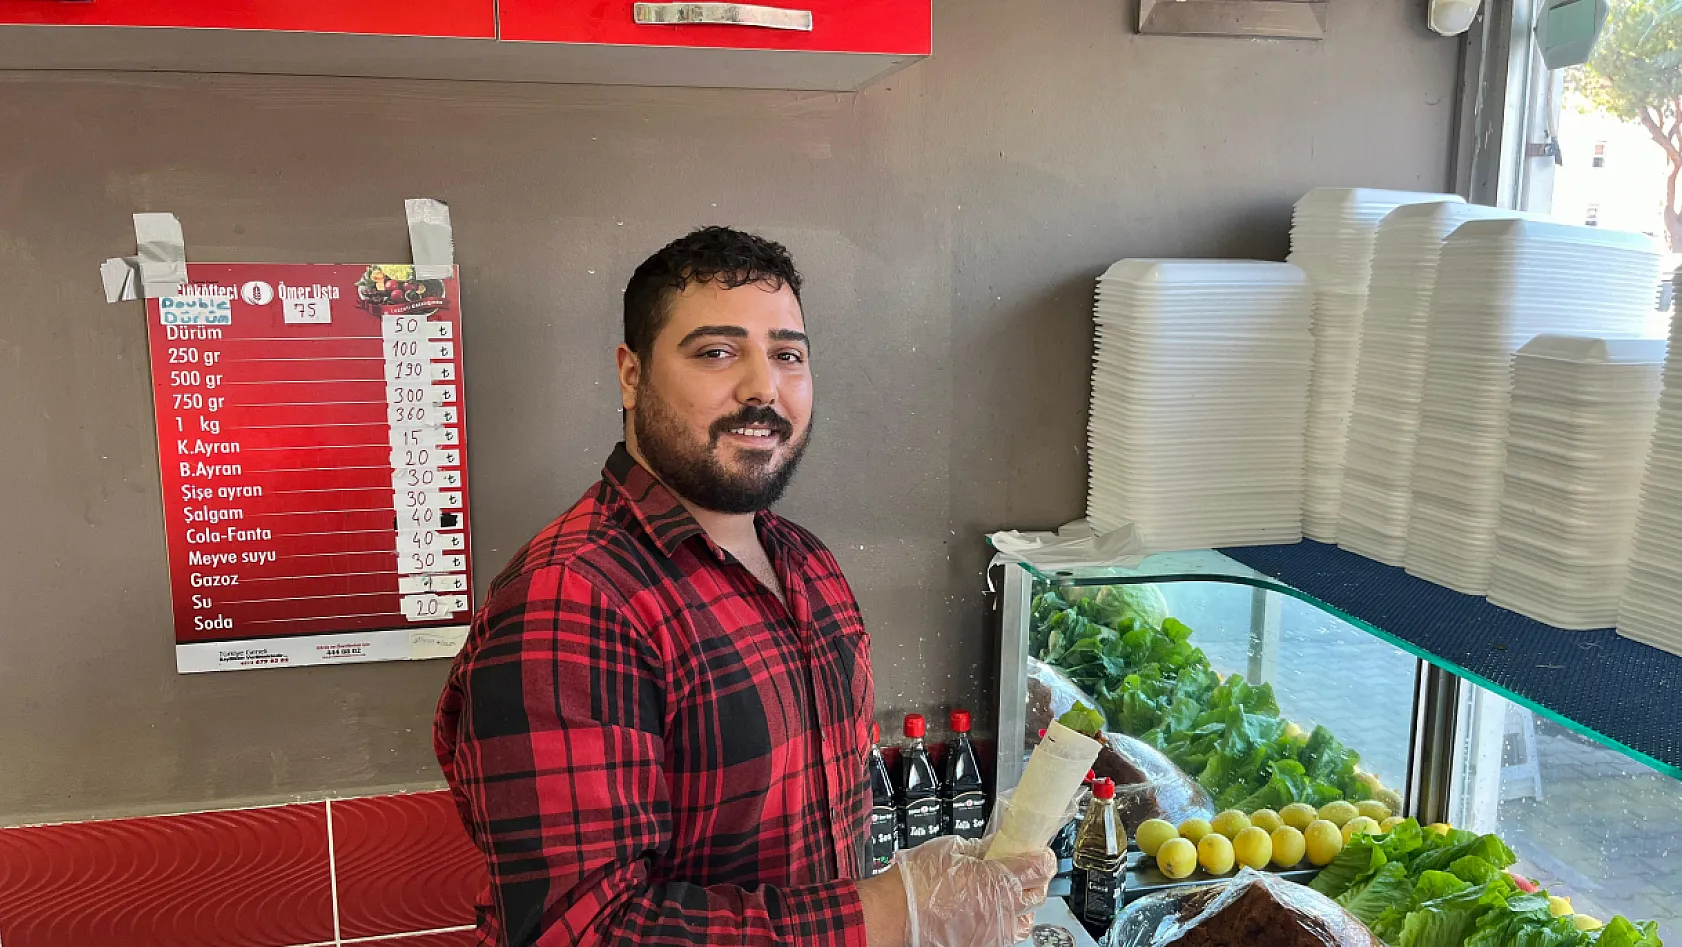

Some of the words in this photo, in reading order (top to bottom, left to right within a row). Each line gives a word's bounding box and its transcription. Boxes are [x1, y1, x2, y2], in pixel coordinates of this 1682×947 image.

[277, 281, 310, 300] Ömer
[312, 284, 340, 301] Usta
[164, 310, 230, 324] Dürüm
[293, 303, 317, 319] 75
[165, 325, 222, 341] Dürüm
[394, 317, 418, 334] 50
[168, 347, 199, 364] 250
[203, 351, 221, 367] gr
[392, 340, 417, 357] 100
[170, 370, 201, 386] 500
[205, 374, 223, 389] gr
[394, 361, 422, 379] 190
[172, 393, 203, 410] 750
[208, 397, 225, 412] gr
[393, 387, 424, 404] 300
[175, 416, 183, 432] 1
[200, 415, 221, 435] kg
[396, 407, 425, 422] 360
[177, 438, 240, 458] K.Ayran
[403, 429, 422, 446] 15
[179, 461, 242, 480] B.Ayran
[405, 449, 429, 466] 20
[181, 484, 214, 502] Şişe
[217, 485, 262, 501] ayran
[407, 468, 434, 487] 30
[183, 505, 244, 524] Şalgam
[406, 490, 427, 508] 30
[186, 526, 272, 544] Cola-Fanta
[411, 507, 433, 527] 40
[188, 550, 238, 569] Meyve
[241, 550, 276, 566] suyu
[412, 531, 433, 549] 40
[190, 572, 240, 588] Gazoz
[411, 553, 435, 570] 30
[191, 594, 213, 610] Su
[194, 613, 234, 631] Soda
[416, 598, 439, 617] 20
